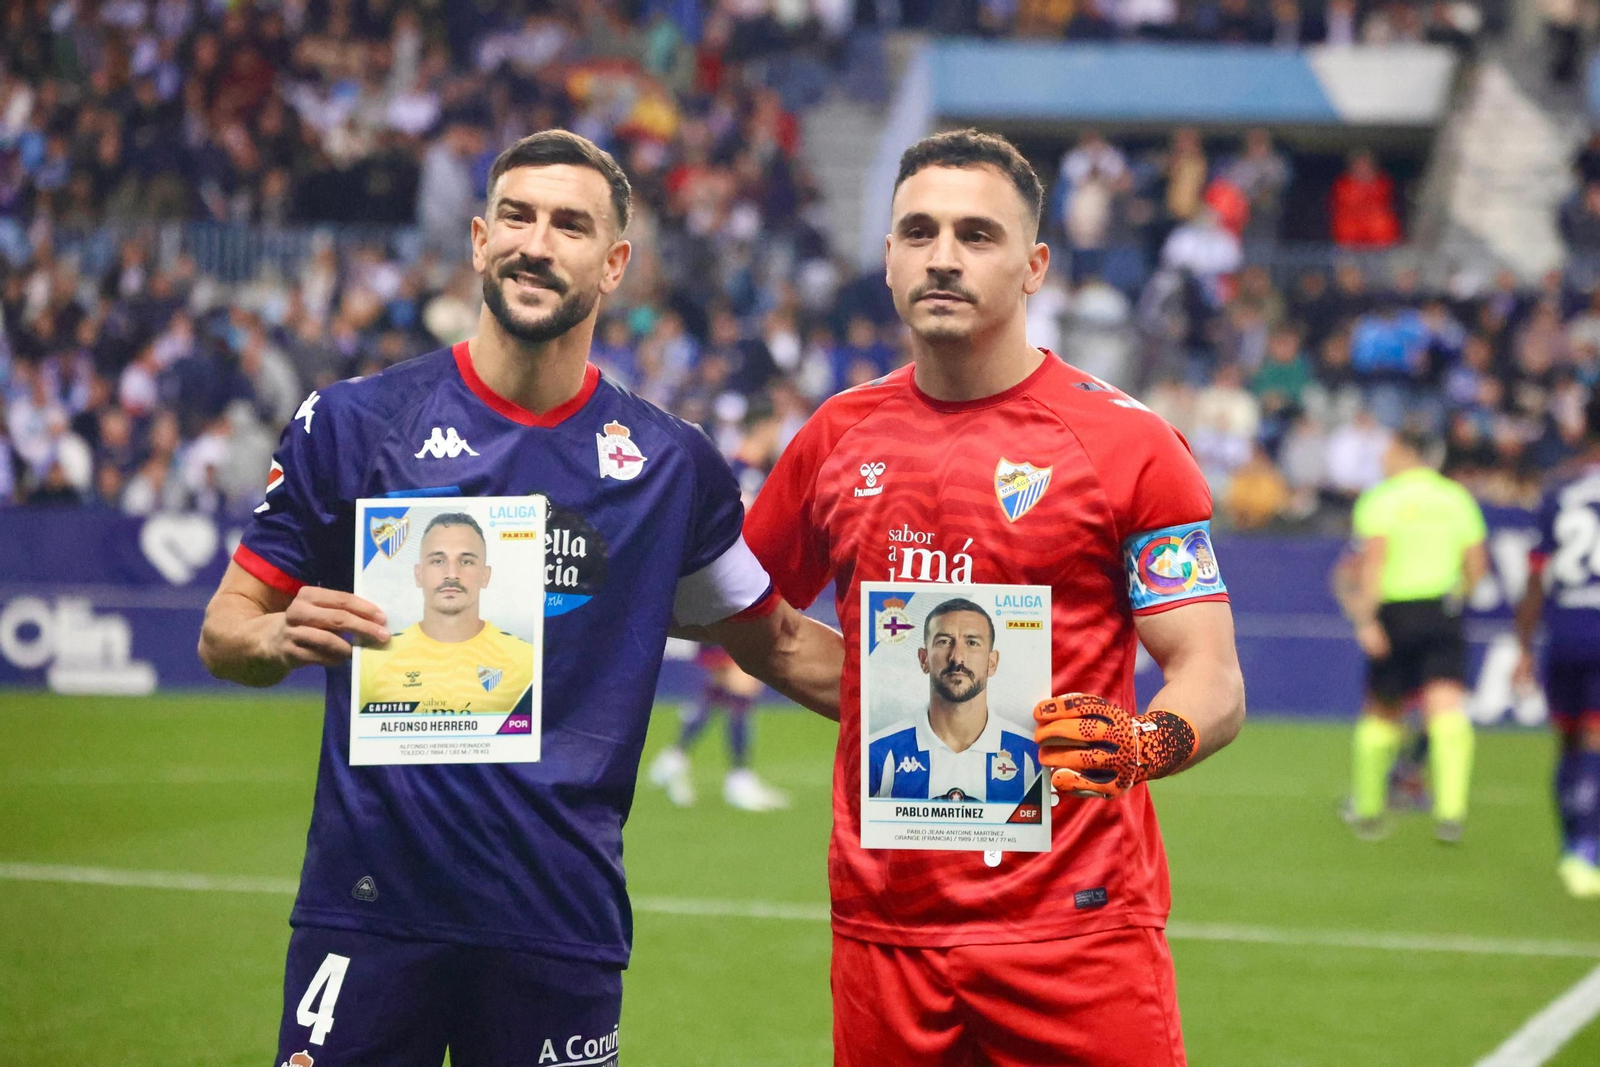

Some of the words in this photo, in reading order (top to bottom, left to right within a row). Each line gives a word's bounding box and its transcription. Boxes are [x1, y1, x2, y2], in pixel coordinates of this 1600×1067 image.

[489, 506, 537, 519] LALIGA
[888, 523, 935, 545] sabor
[1552, 503, 1600, 581] 2
[898, 537, 976, 585] má
[995, 594, 1043, 608] LALIGA
[368, 702, 411, 713] CAPITÁN
[380, 721, 428, 732] ALFONSO
[429, 720, 478, 732] HERRERO
[508, 719, 528, 729] POR
[895, 806, 930, 818] PABLO
[930, 805, 984, 819] MARTÍNEZ
[1019, 809, 1037, 818] DEF
[296, 952, 351, 1046] 4
[538, 1038, 559, 1064] A
